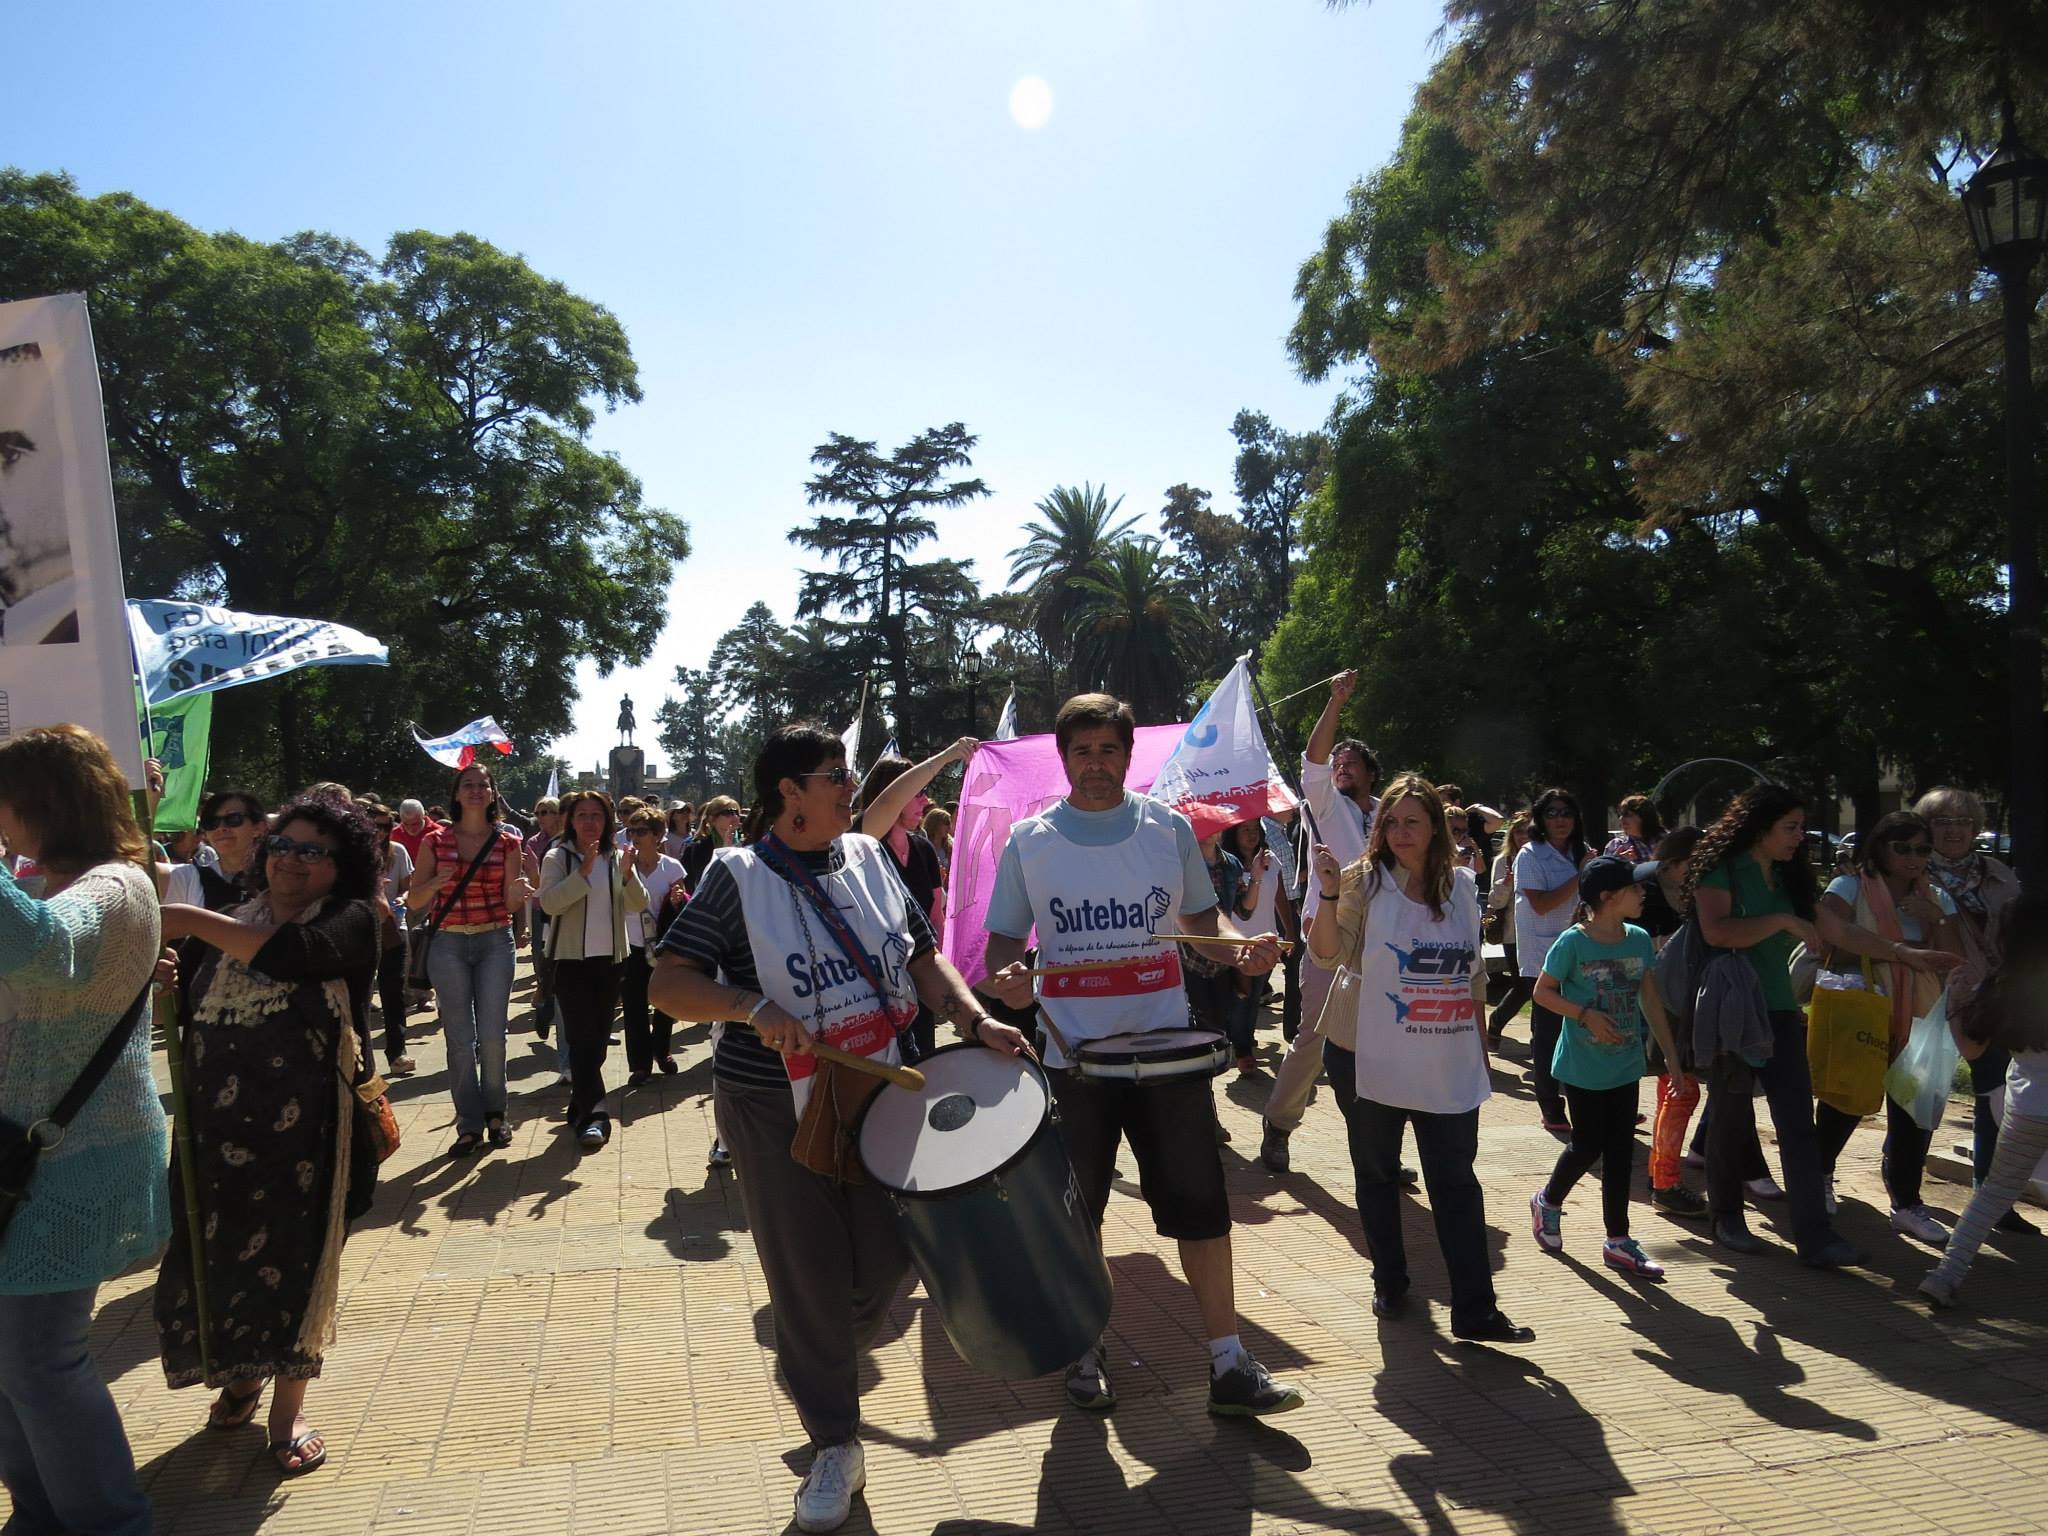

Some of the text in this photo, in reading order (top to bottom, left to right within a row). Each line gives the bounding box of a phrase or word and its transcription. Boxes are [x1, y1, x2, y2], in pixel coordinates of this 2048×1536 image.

[168, 632, 229, 655] para
[1050, 897, 1145, 935] Suteba
[1411, 938, 1460, 950] Buenos
[786, 953, 885, 998] Sutea
[1405, 1024, 1418, 1034] de
[1419, 1024, 1433, 1034] los
